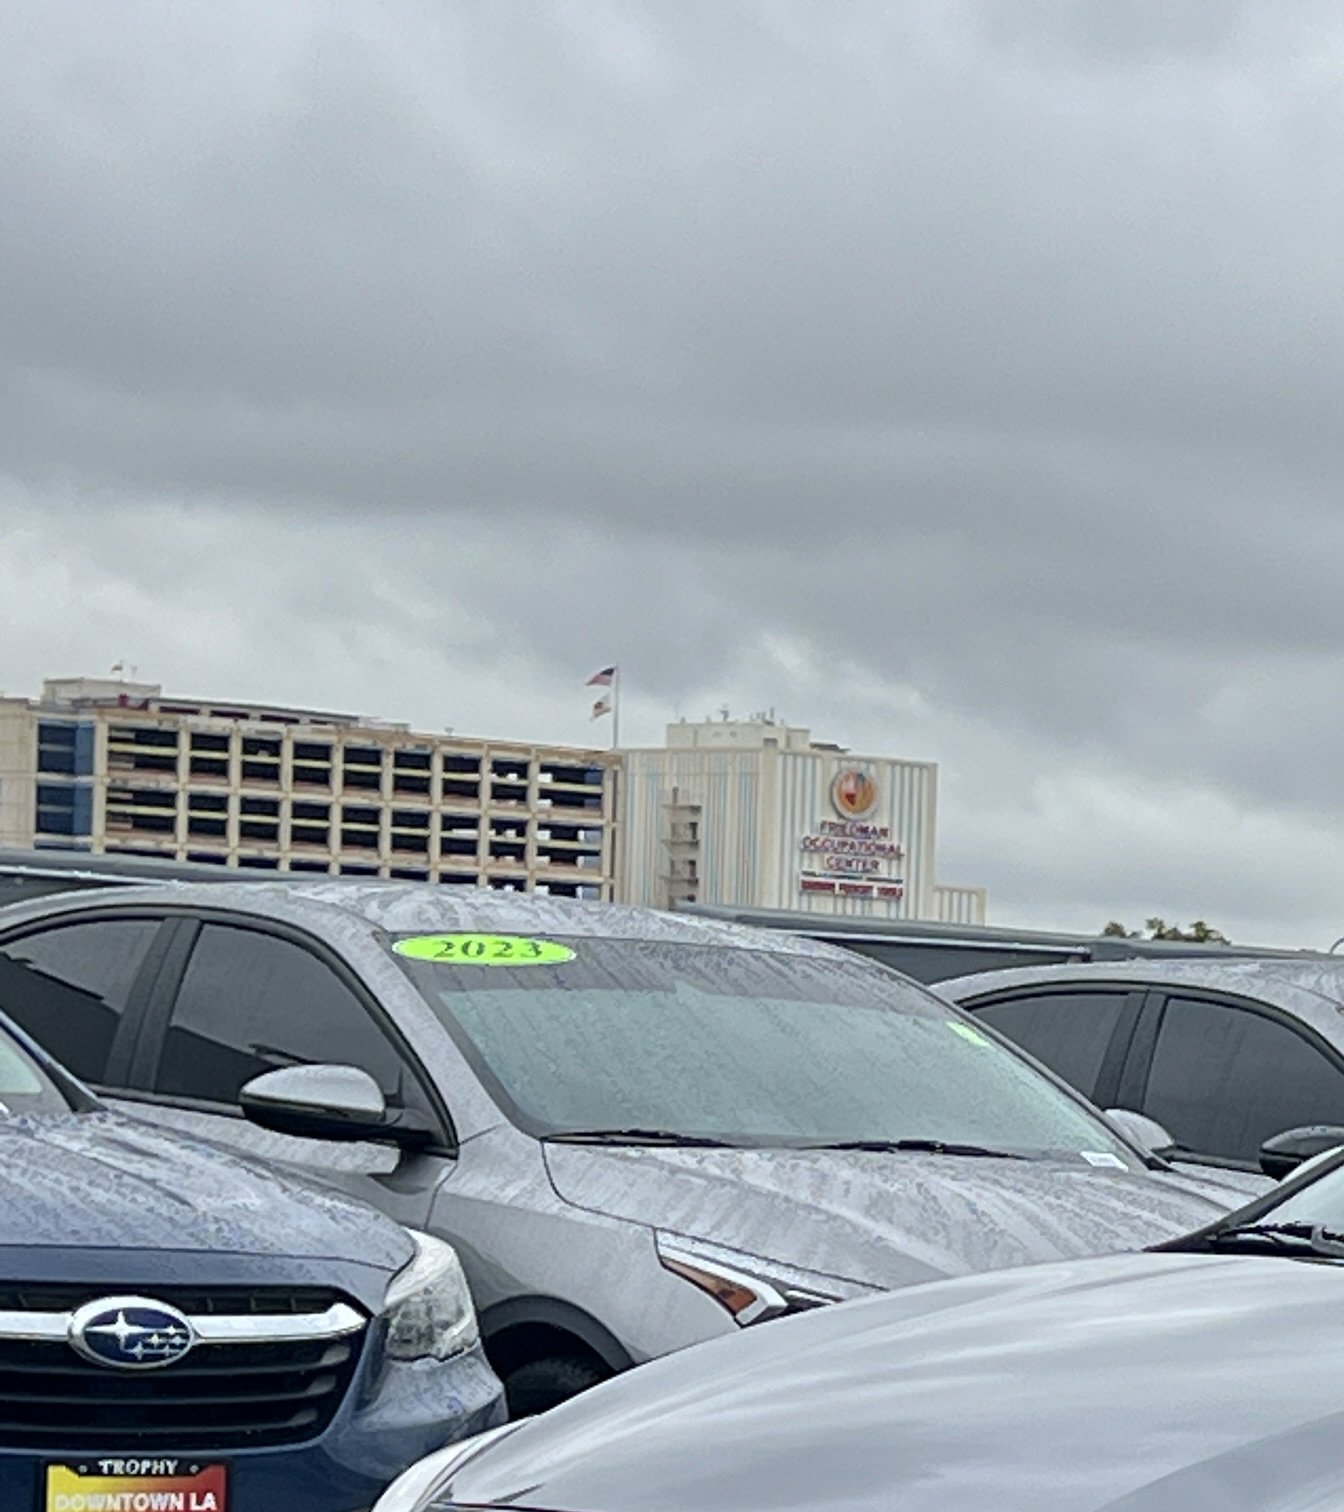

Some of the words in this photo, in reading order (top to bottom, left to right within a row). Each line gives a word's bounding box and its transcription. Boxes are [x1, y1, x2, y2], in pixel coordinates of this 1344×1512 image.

[433, 939, 543, 958] 2023
[98, 1459, 180, 1475] TROPHY
[54, 1493, 184, 1512] DOWNTOWN
[189, 1492, 218, 1511] LA
